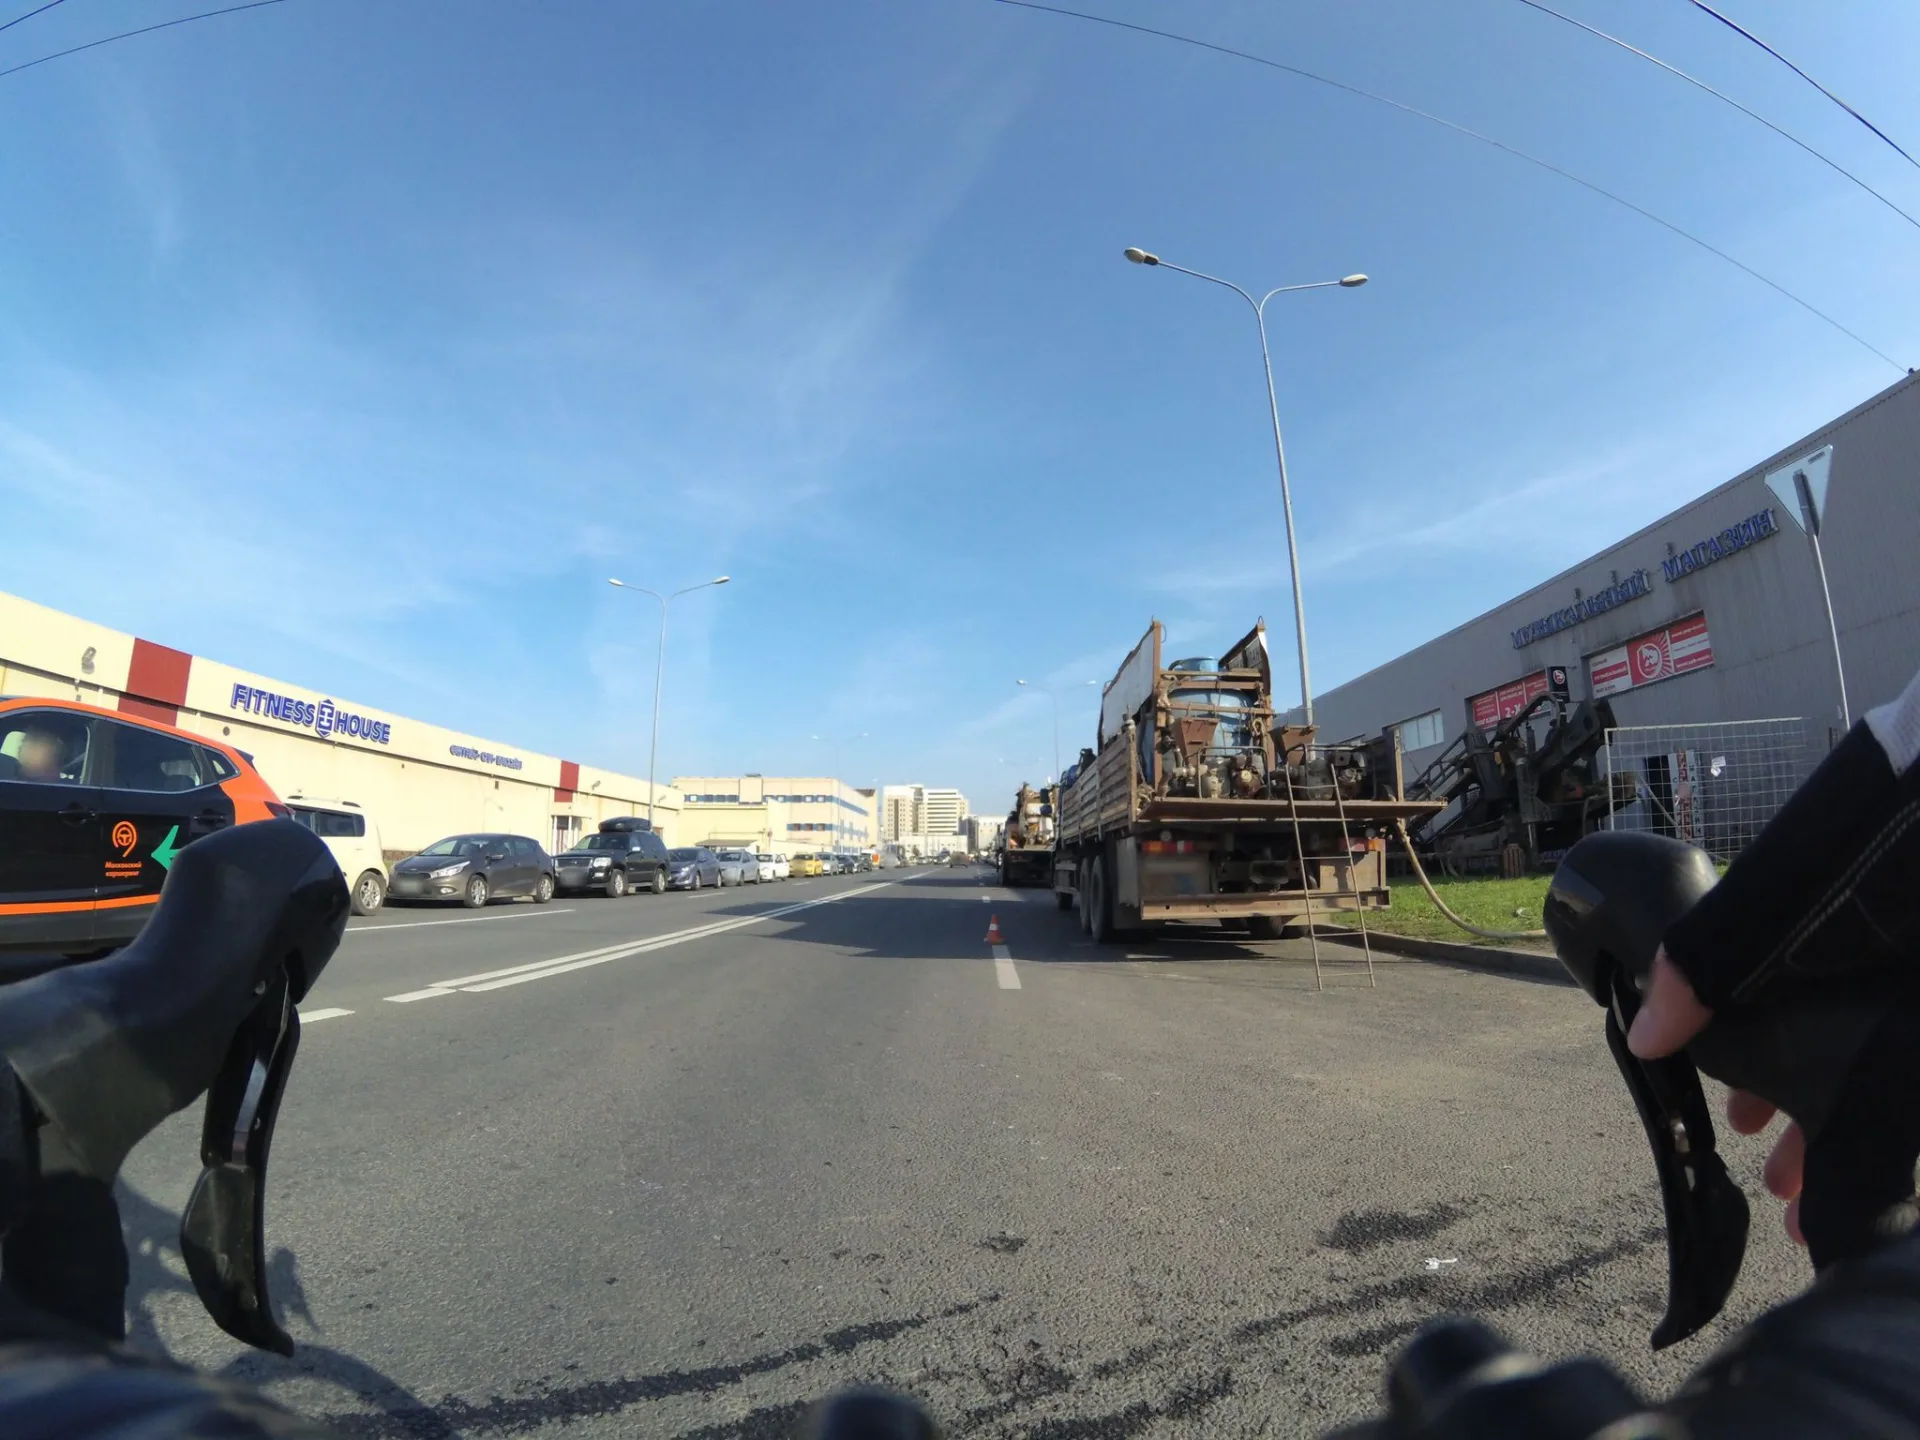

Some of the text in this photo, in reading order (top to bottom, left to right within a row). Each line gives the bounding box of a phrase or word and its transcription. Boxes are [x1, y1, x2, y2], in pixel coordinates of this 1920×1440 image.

[1511, 508, 1779, 650] МУЗЫКАЛЬНЫЙ МАГАЗИН
[231, 682, 391, 745] FITNESS HOUSE
